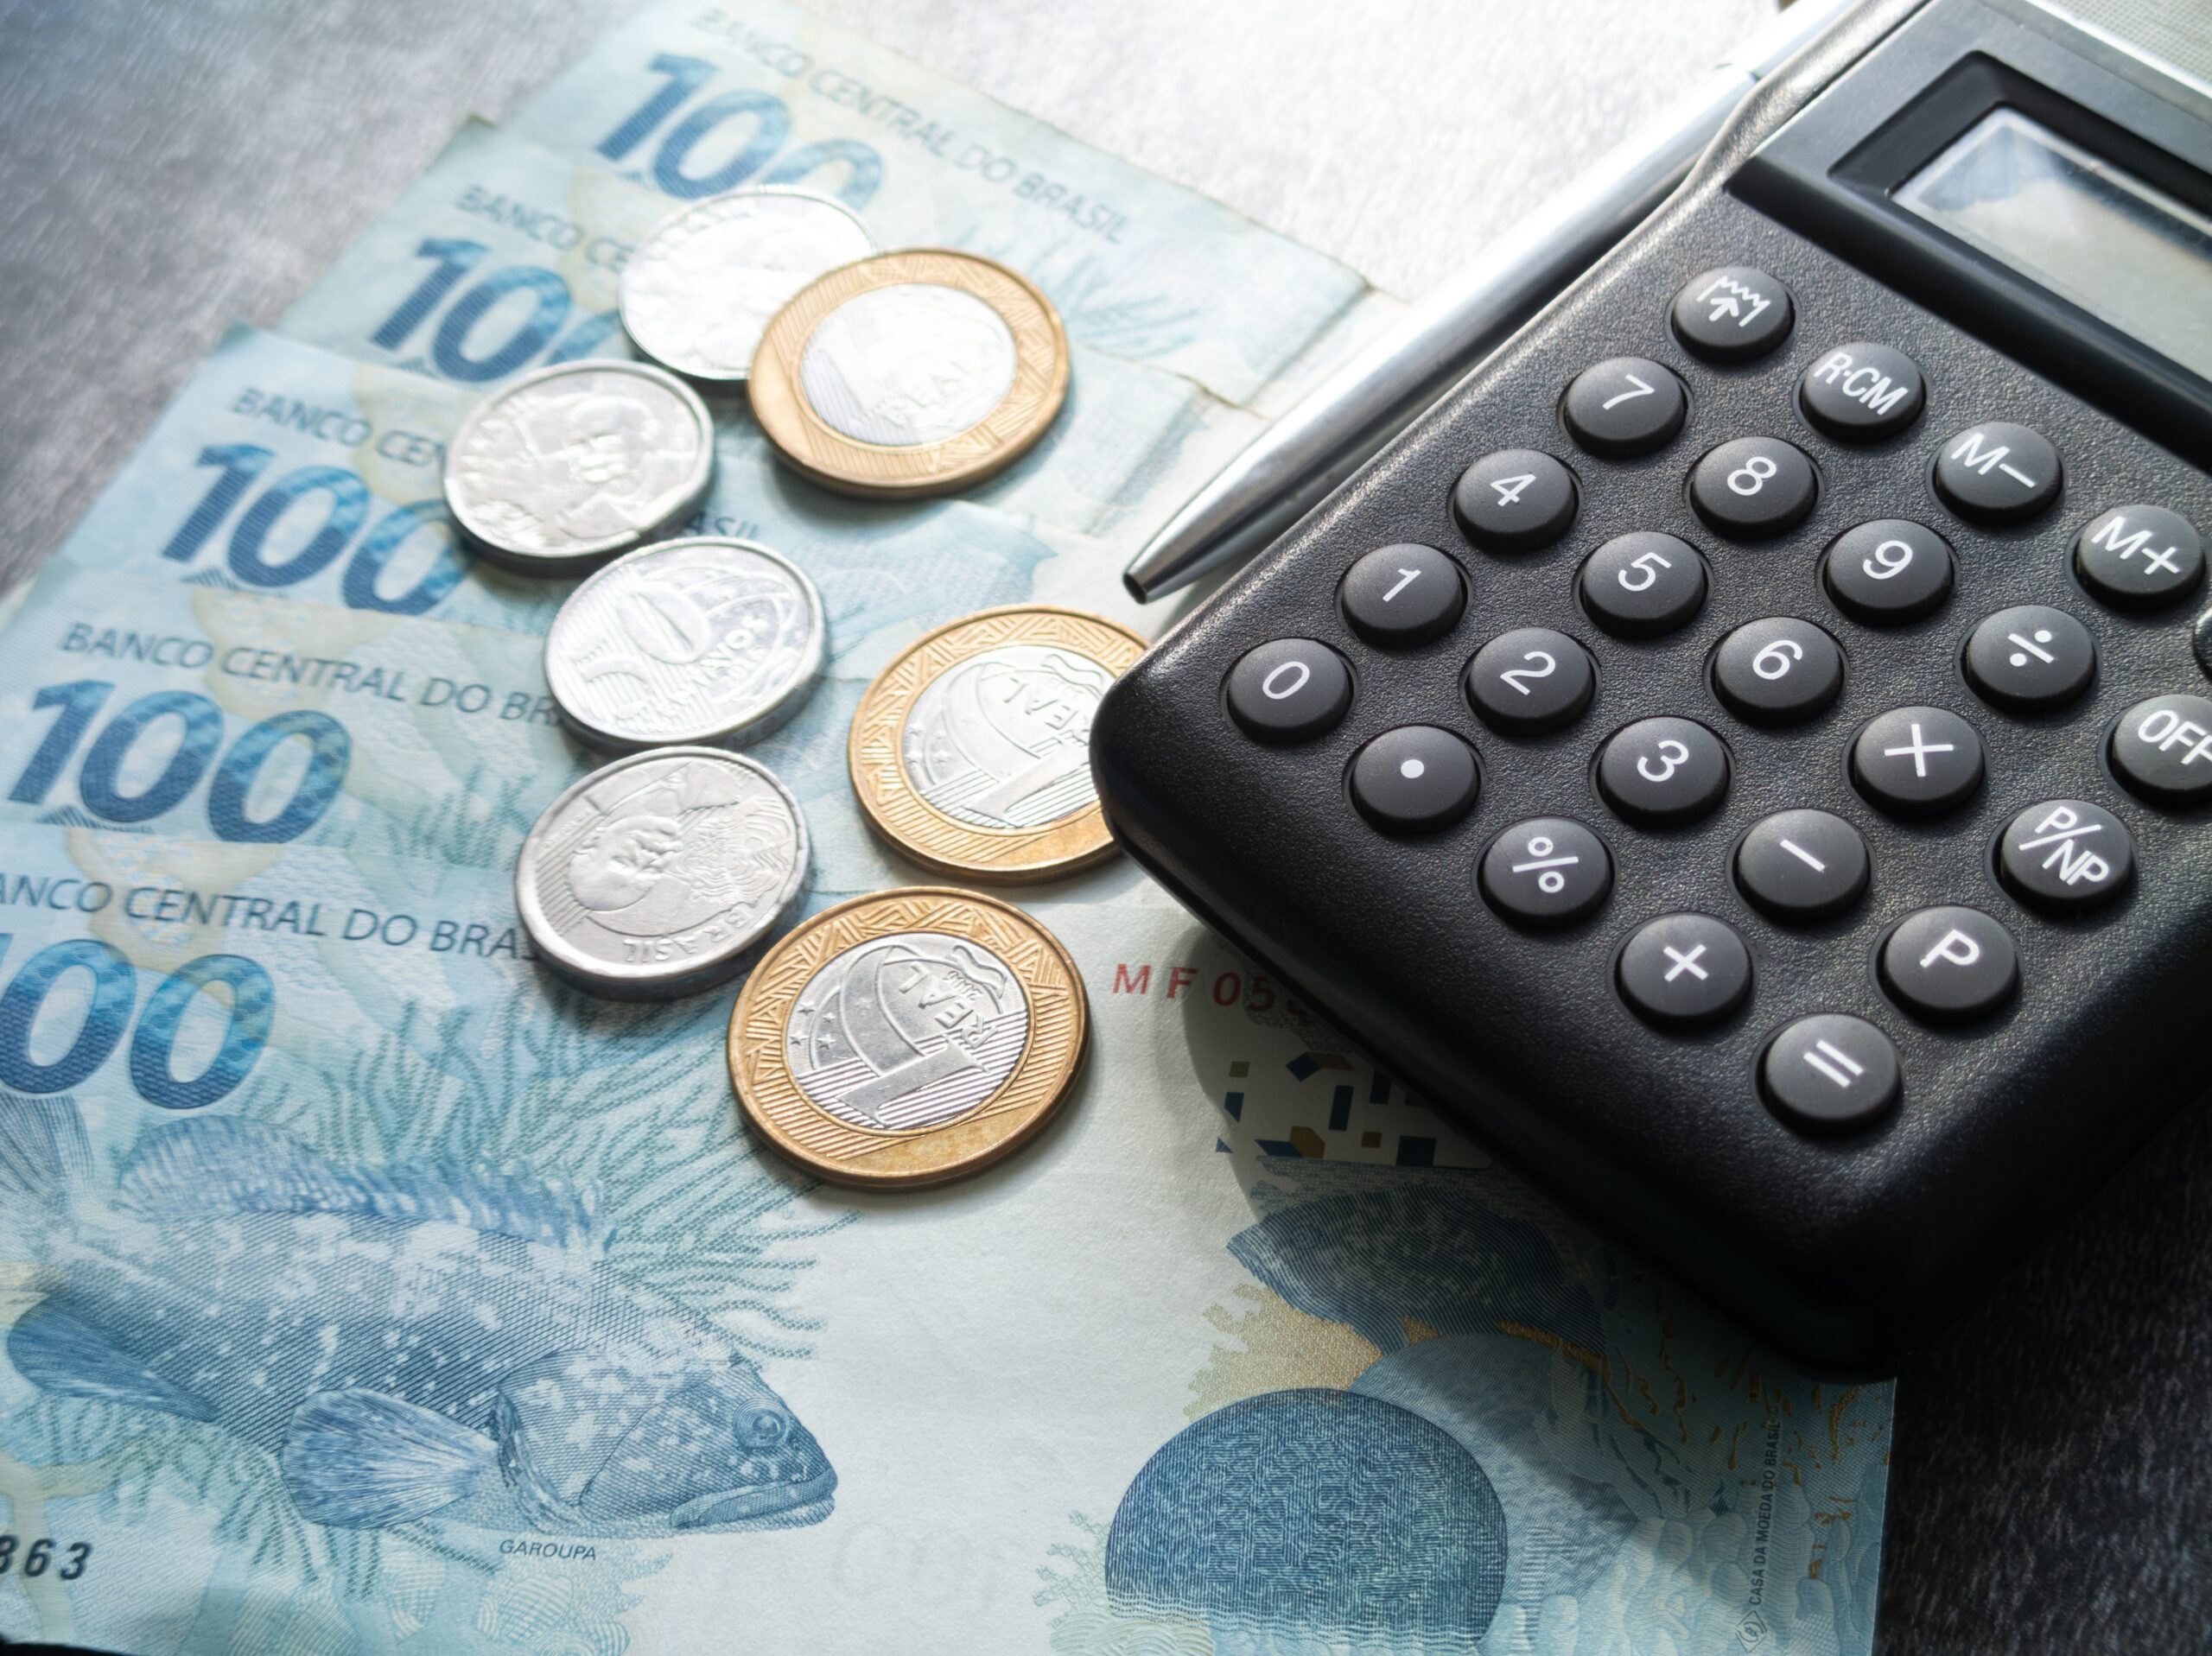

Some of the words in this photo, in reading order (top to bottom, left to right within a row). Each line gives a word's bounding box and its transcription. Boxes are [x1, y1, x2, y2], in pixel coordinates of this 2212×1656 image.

[596, 53, 883, 213] 100
[808, 69, 957, 159] CENTRAL
[953, 144, 1017, 184] DO
[1012, 172, 1131, 244] BRASIL
[455, 184, 585, 251] BANCO
[370, 238, 620, 383] 10
[1603, 373, 1654, 409] 7
[231, 387, 373, 447] BANCO
[1491, 474, 1535, 506] 4
[1727, 457, 1777, 496] 8
[162, 443, 470, 615] 100
[2091, 516, 2179, 574] M+
[1618, 552, 1671, 591] 5
[1863, 540, 1913, 579] 9
[1382, 568, 1421, 602] 1
[63, 623, 213, 669] BANCO
[221, 645, 407, 703] CENTRAL
[420, 676, 491, 714] DO
[1262, 661, 1310, 700] 0
[1500, 650, 1556, 695] 2
[1753, 640, 1802, 680] 6
[8, 679, 353, 844] 100
[1637, 739, 1689, 782] 3
[1513, 836, 1579, 892] %
[125, 886, 326, 938] CENTRAL
[342, 908, 419, 946] DO
[429, 919, 541, 961] BRA
[622, 905, 753, 963] BRASIL
[1920, 929, 1980, 968] P
[0, 932, 276, 1110] 00
[898, 960, 1000, 1050] REAL
[1764, 1420, 1783, 1467] BRASIL
[1761, 1469, 1777, 1491] DO
[1755, 1492, 1774, 1544] MOEDA
[499, 1539, 596, 1561] GAROUPA
[1752, 1545, 1767, 1567] DA
[1748, 1567, 1765, 1606] CASA
